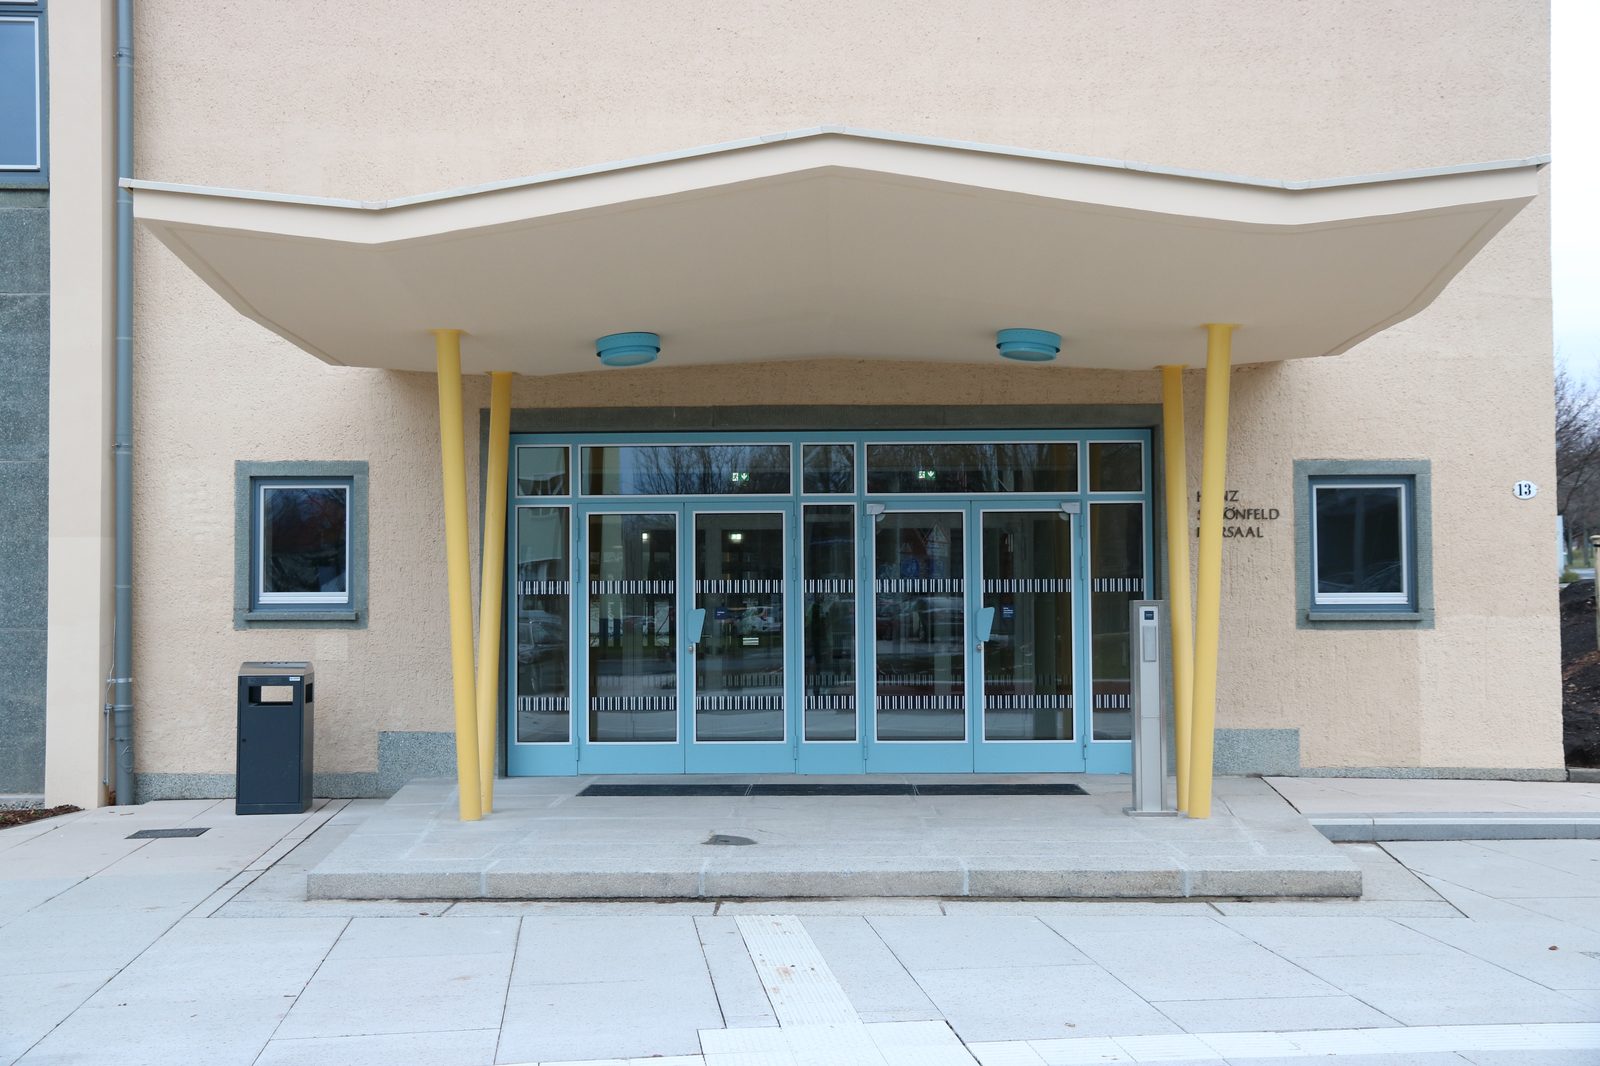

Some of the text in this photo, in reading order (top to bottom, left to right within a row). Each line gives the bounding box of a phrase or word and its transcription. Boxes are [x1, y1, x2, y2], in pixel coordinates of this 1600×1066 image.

[1518, 483, 1531, 496] 13
[1196, 506, 1280, 520] ÖNFELD
[1196, 526, 1264, 538] RSAAL
